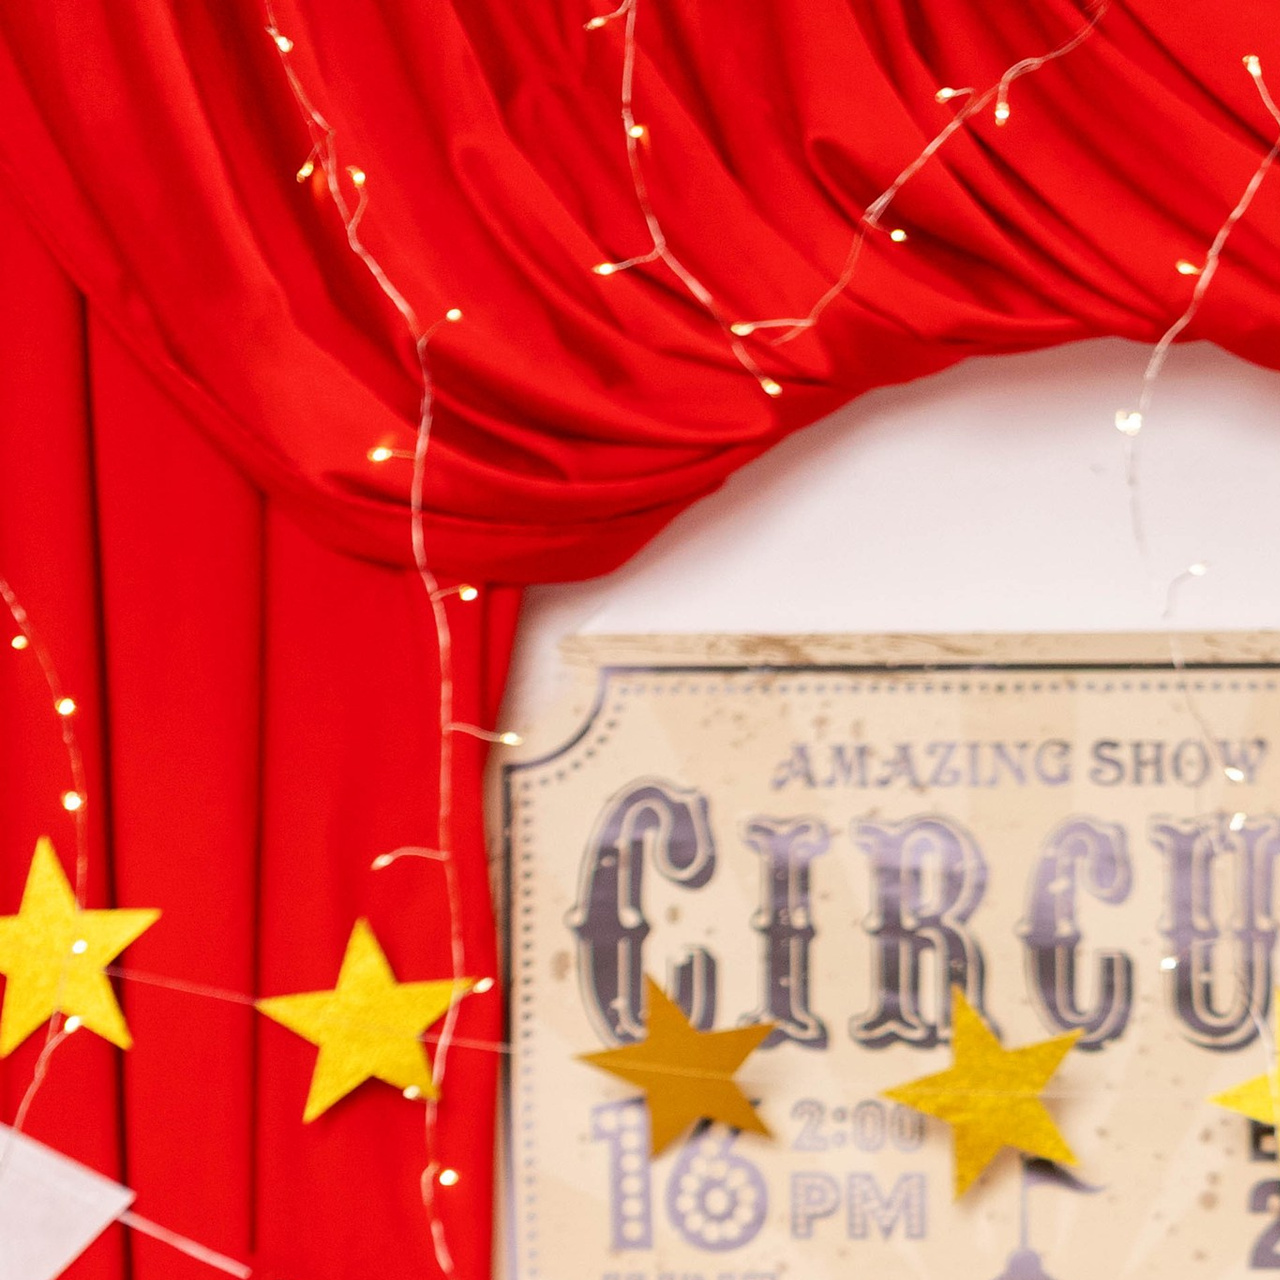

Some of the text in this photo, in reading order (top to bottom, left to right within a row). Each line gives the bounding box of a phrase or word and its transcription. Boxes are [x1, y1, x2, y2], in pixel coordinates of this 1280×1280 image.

[770, 734, 1271, 790] AMAZING SHOW
[789, 1098, 927, 1153] 2:00
[591, 1094, 770, 1254] 16
[789, 1171, 927, 1240] PM
